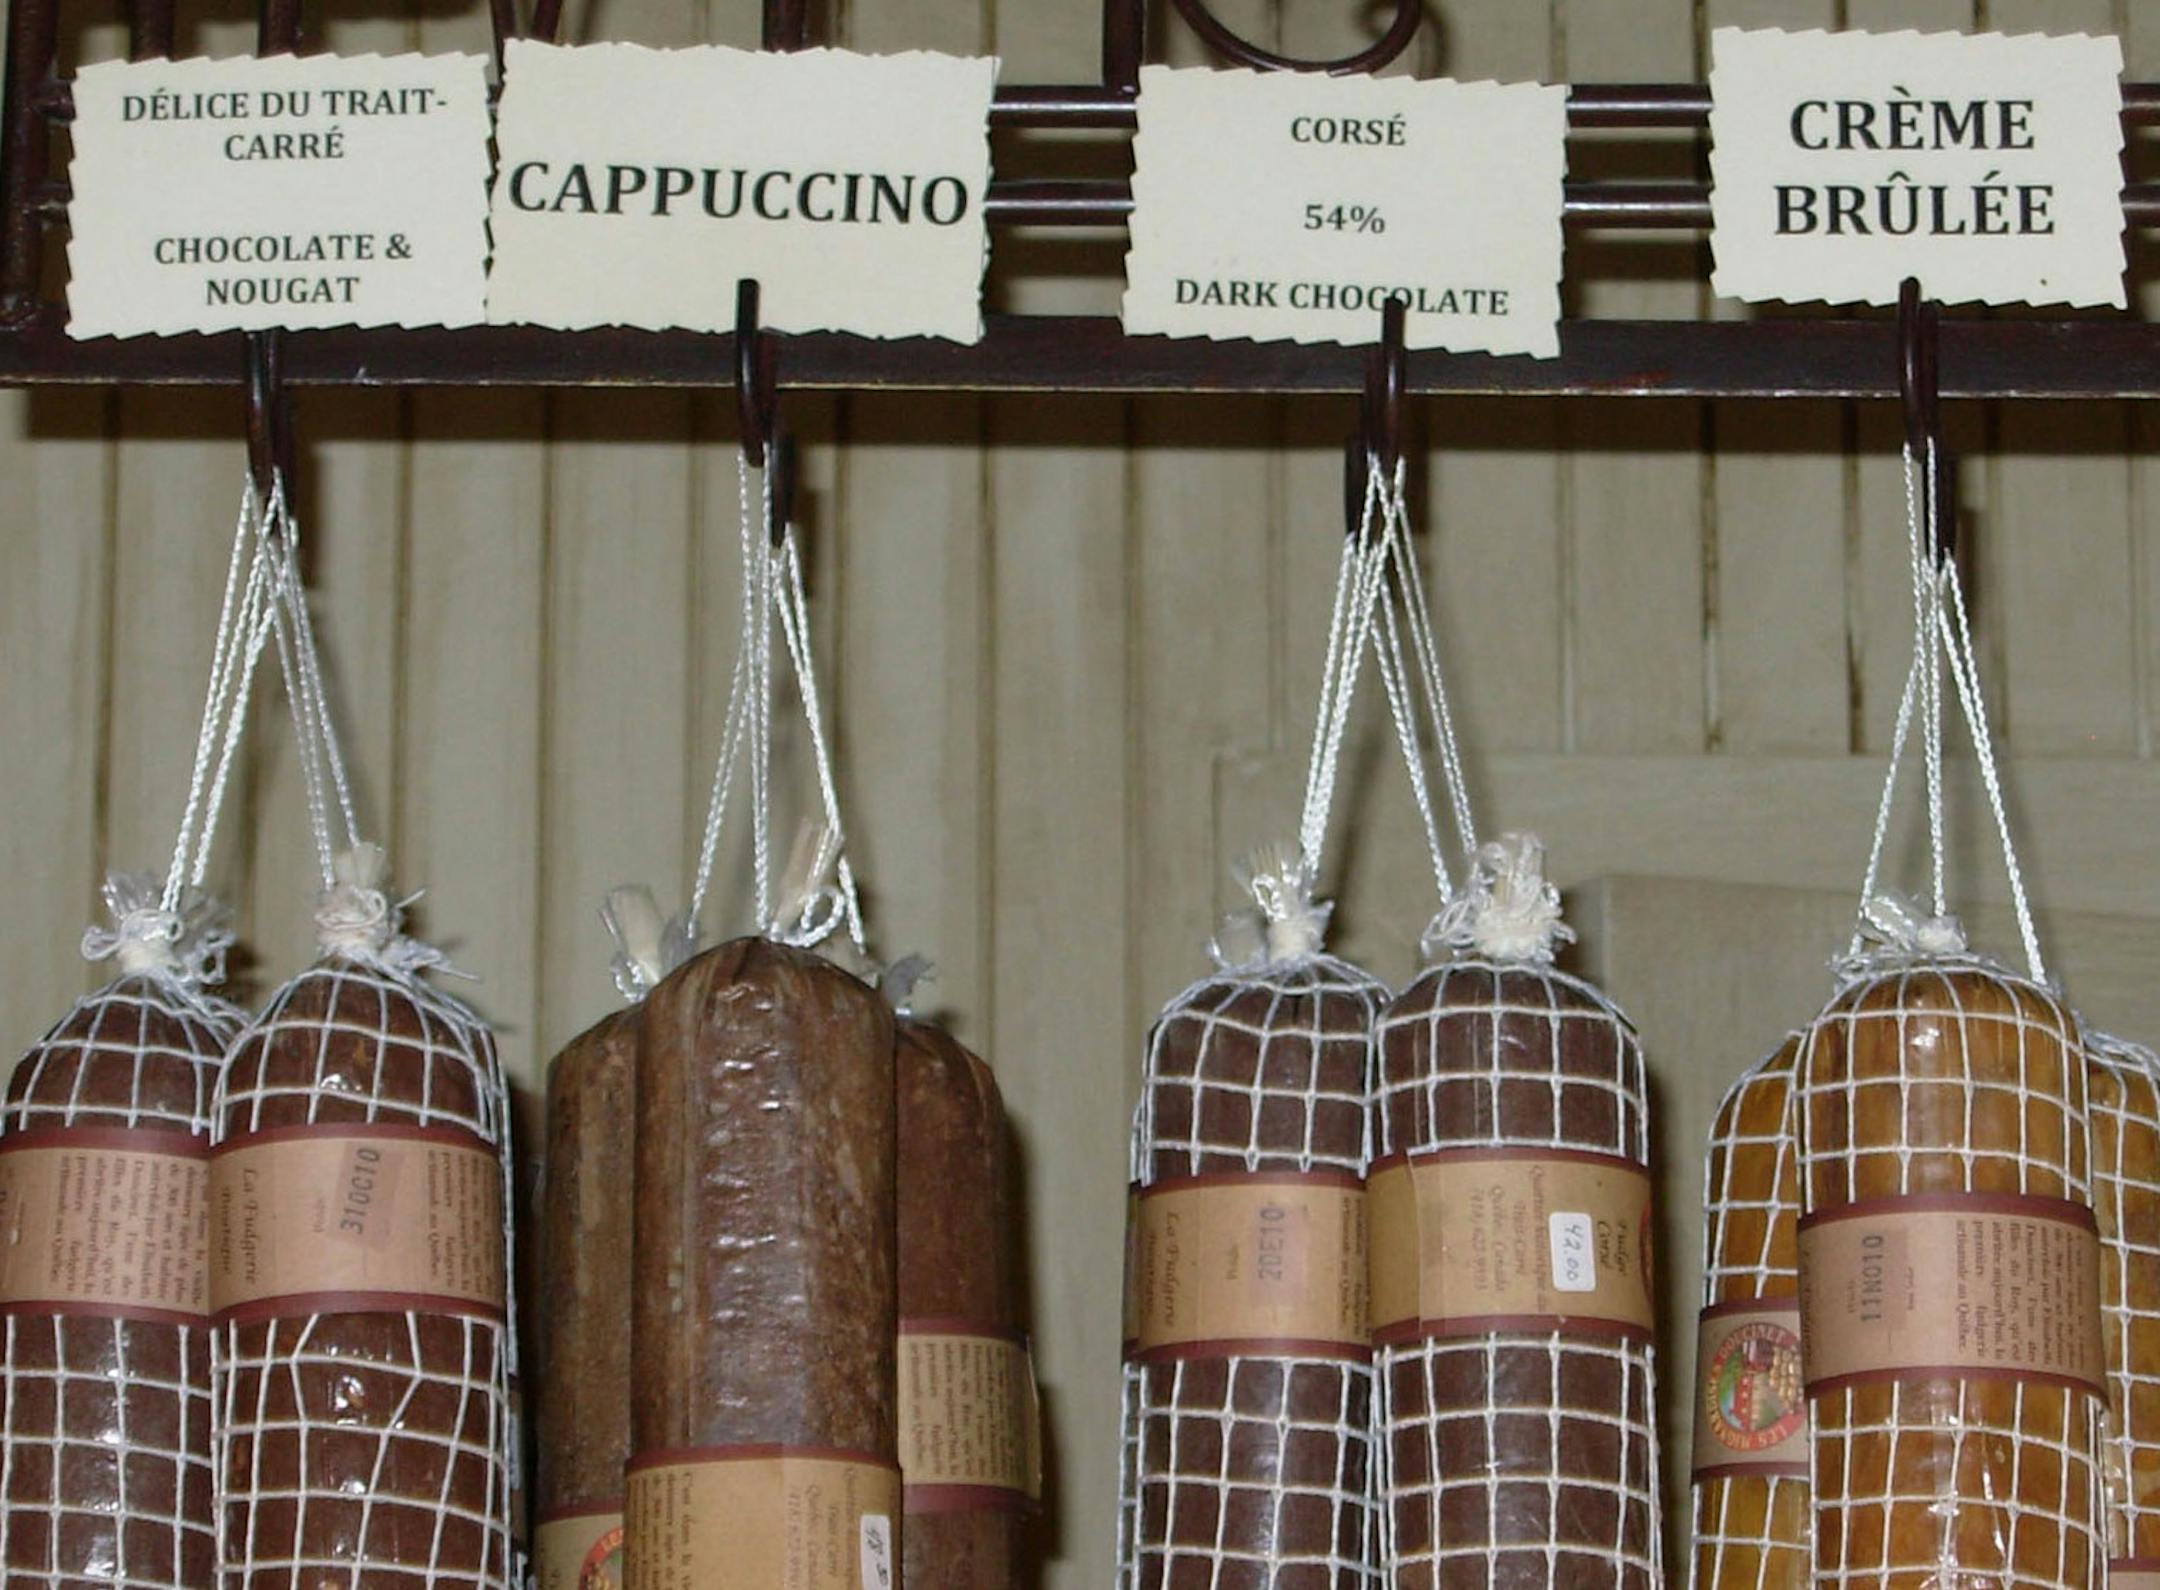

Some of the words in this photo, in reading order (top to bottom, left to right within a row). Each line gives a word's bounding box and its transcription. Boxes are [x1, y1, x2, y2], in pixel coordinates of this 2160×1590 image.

[123, 87, 249, 122] DÉLICE
[261, 91, 310, 118] DU
[322, 88, 446, 116] TRAIT-
[1790, 85, 2035, 150] CRÈME
[224, 125, 344, 161] CARRÉ
[1291, 113, 1406, 146] CORSÉ
[509, 161, 968, 226] CAPPUCCINO
[1774, 170, 2055, 236] BRÛLÉE
[1304, 204, 1385, 233] 54%
[155, 234, 374, 265] CHOCOLATE
[385, 234, 411, 260] &
[207, 277, 360, 305] NOUGAT
[1176, 279, 1277, 307] DARK
[1289, 283, 1508, 316] CHOCOLATE
[1562, 1223, 1584, 1283] 42.00
